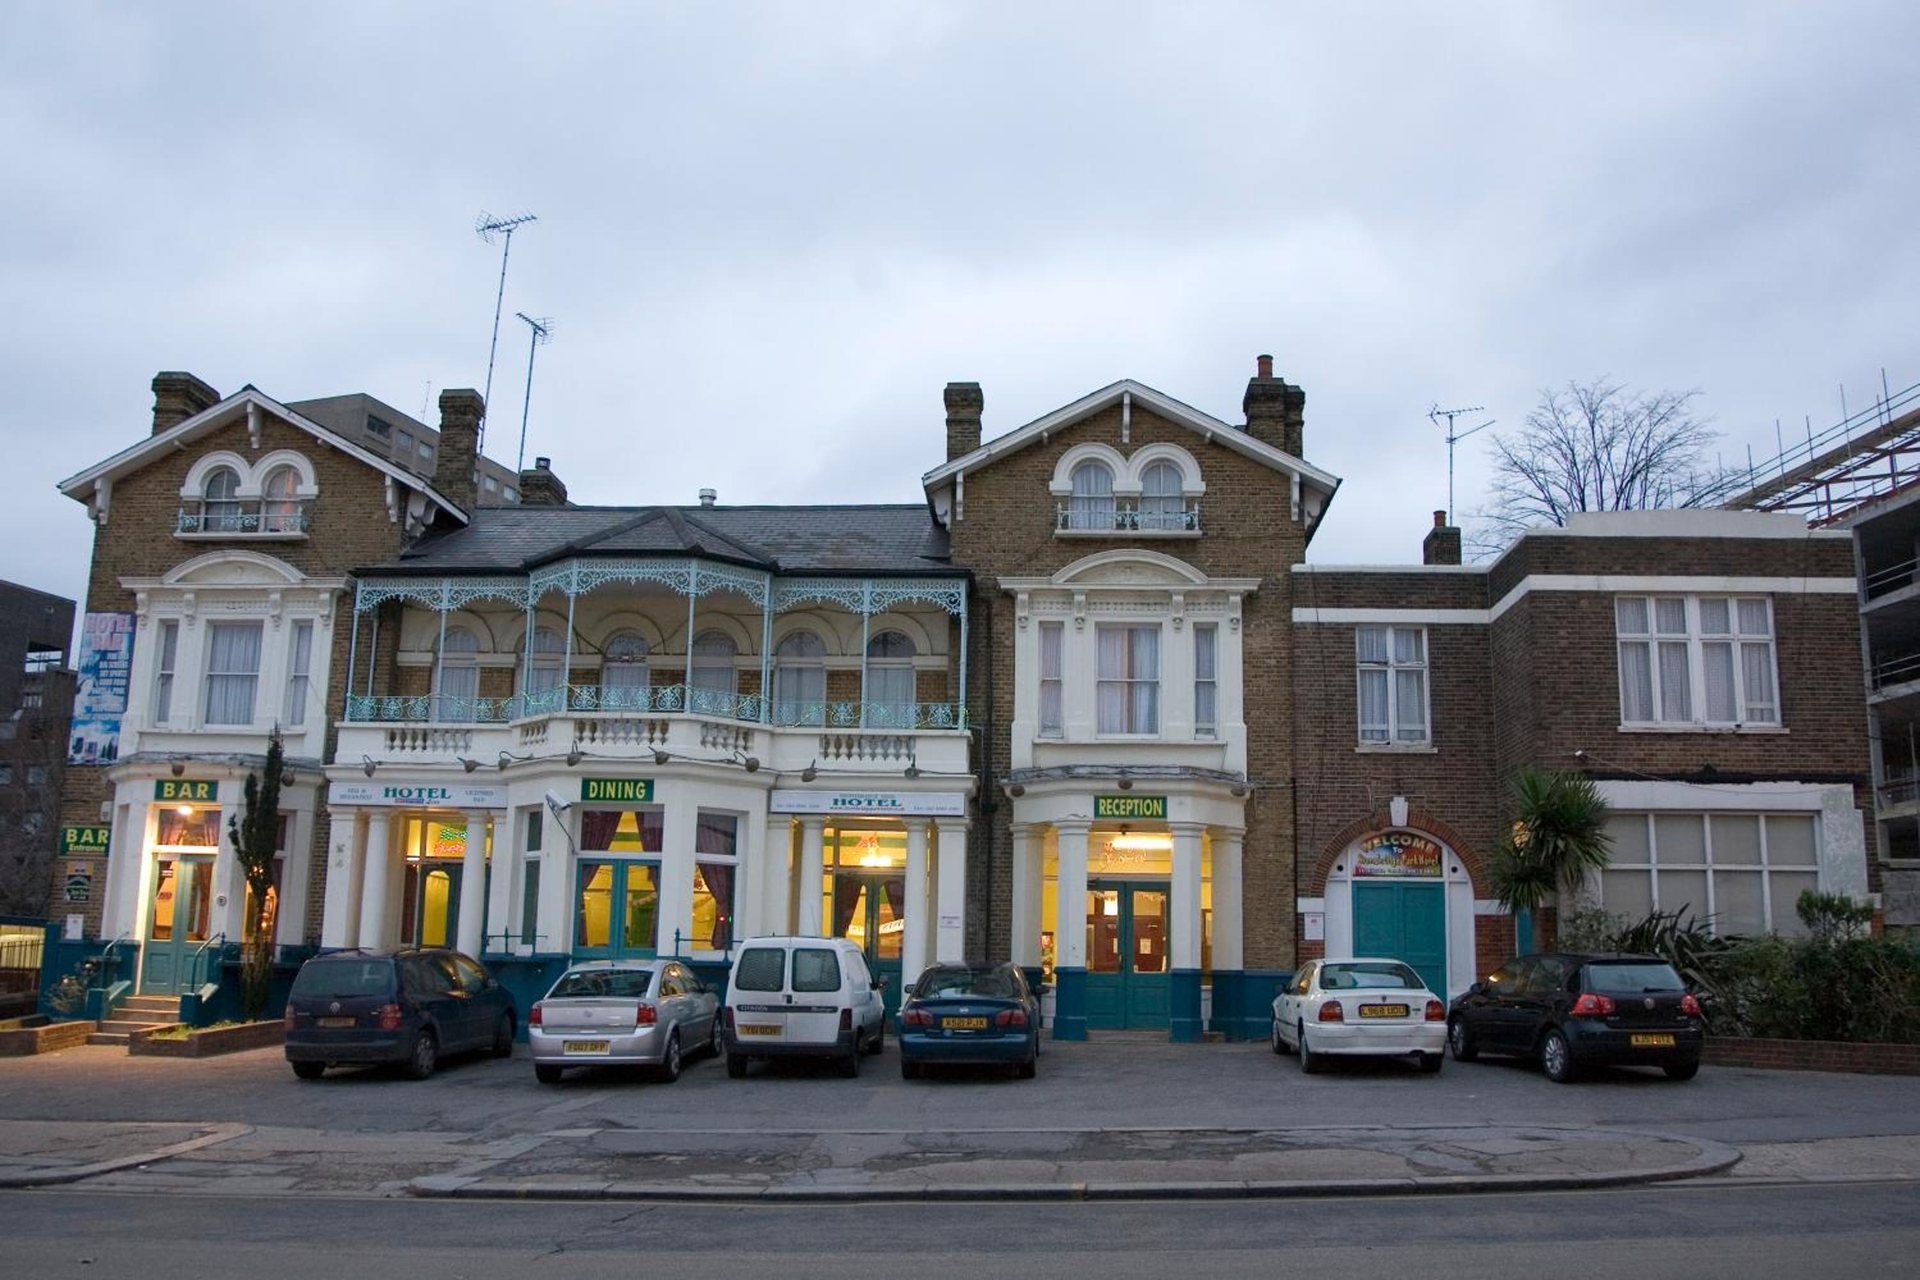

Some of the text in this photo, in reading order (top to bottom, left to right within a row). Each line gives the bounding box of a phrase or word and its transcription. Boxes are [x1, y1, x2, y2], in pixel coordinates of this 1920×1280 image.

[85, 611, 133, 632] HOTEL
[93, 632, 124, 651] BAR
[162, 782, 209, 798] BAR
[384, 787, 451, 800] HOTEL
[589, 781, 646, 799] DINING
[833, 798, 902, 807] HOTEL
[1099, 798, 1163, 816] RECEPTION
[66, 828, 109, 844] BAR
[1361, 834, 1438, 852] WELCOME
[69, 843, 106, 852] Entrance
[1393, 846, 1404, 854] To
